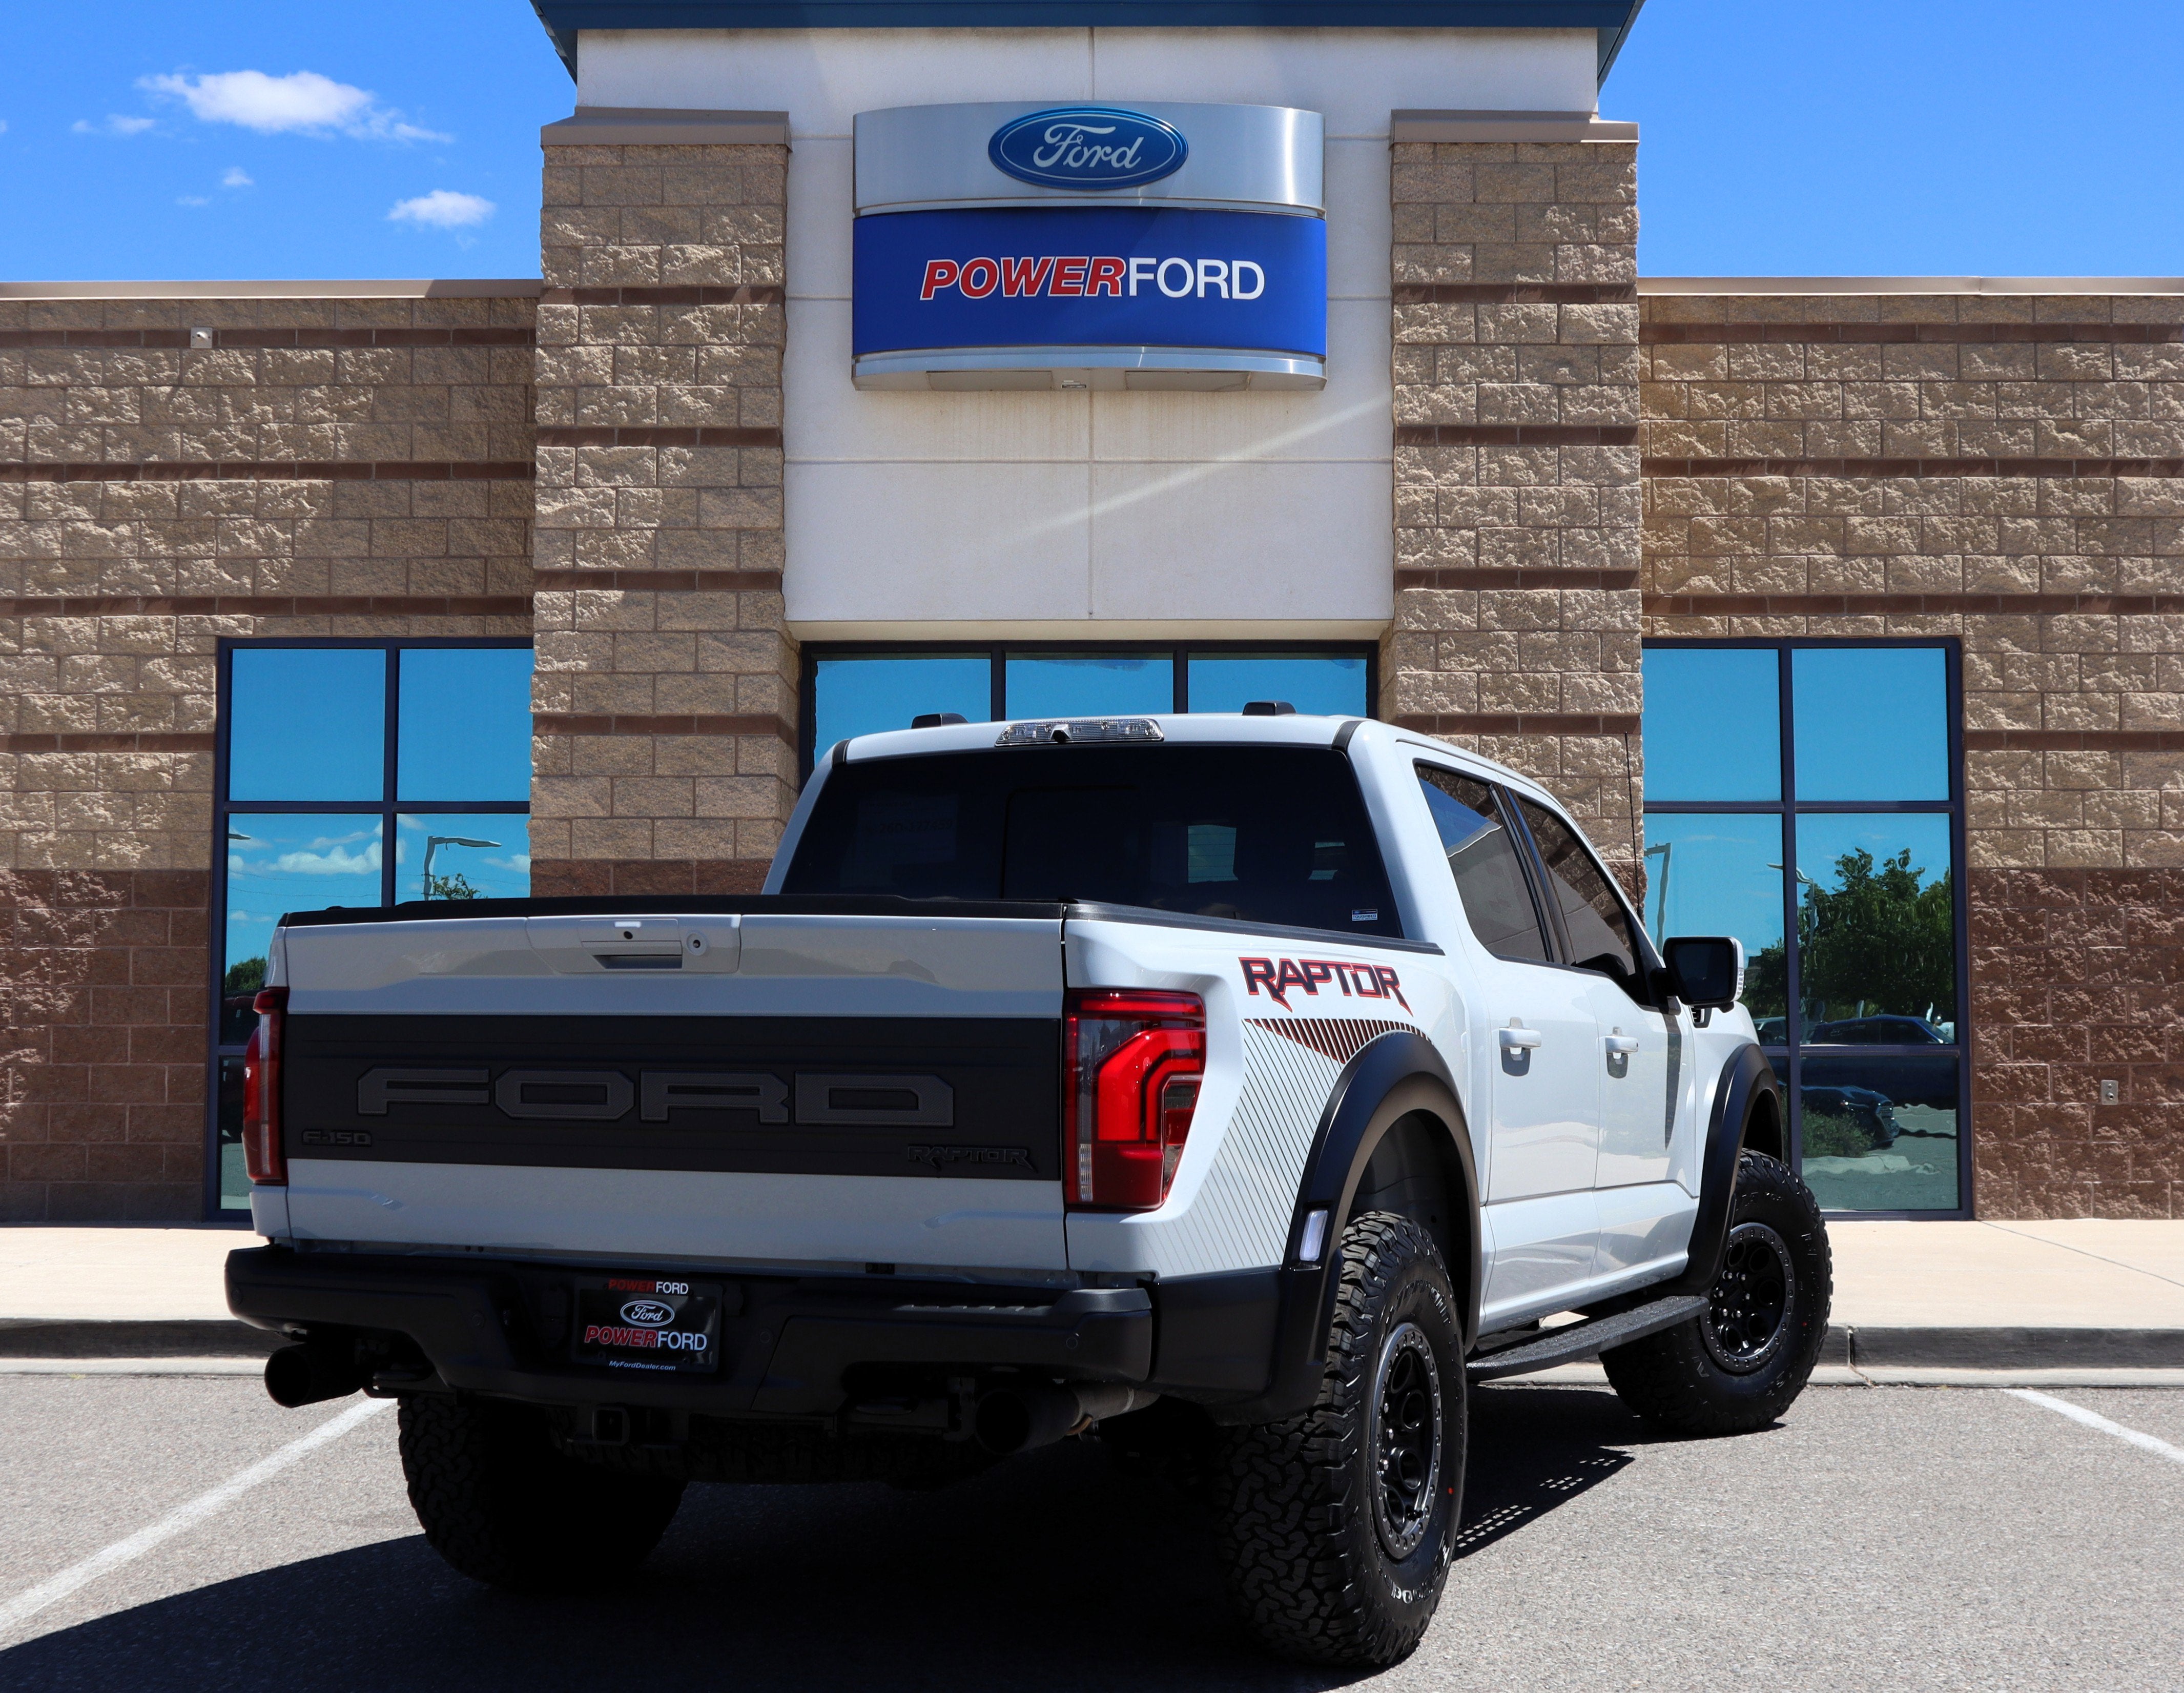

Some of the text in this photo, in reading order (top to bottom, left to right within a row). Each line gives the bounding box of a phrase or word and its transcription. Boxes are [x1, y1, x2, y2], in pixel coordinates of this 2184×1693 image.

[1032, 123, 1145, 169] Ford
[920, 256, 1266, 301] POWERFORD
[1238, 957, 1414, 1018] RAPTOR
[357, 1064, 955, 1129] FORD
[302, 1129, 373, 1147] F-150
[908, 1145, 1037, 1172] RAPTOR
[608, 1278, 689, 1295] POWERFORD
[631, 1304, 665, 1322] Ford
[584, 1325, 708, 1351] POWERFORD
[609, 1360, 676, 1372] MyFordDealer.com
